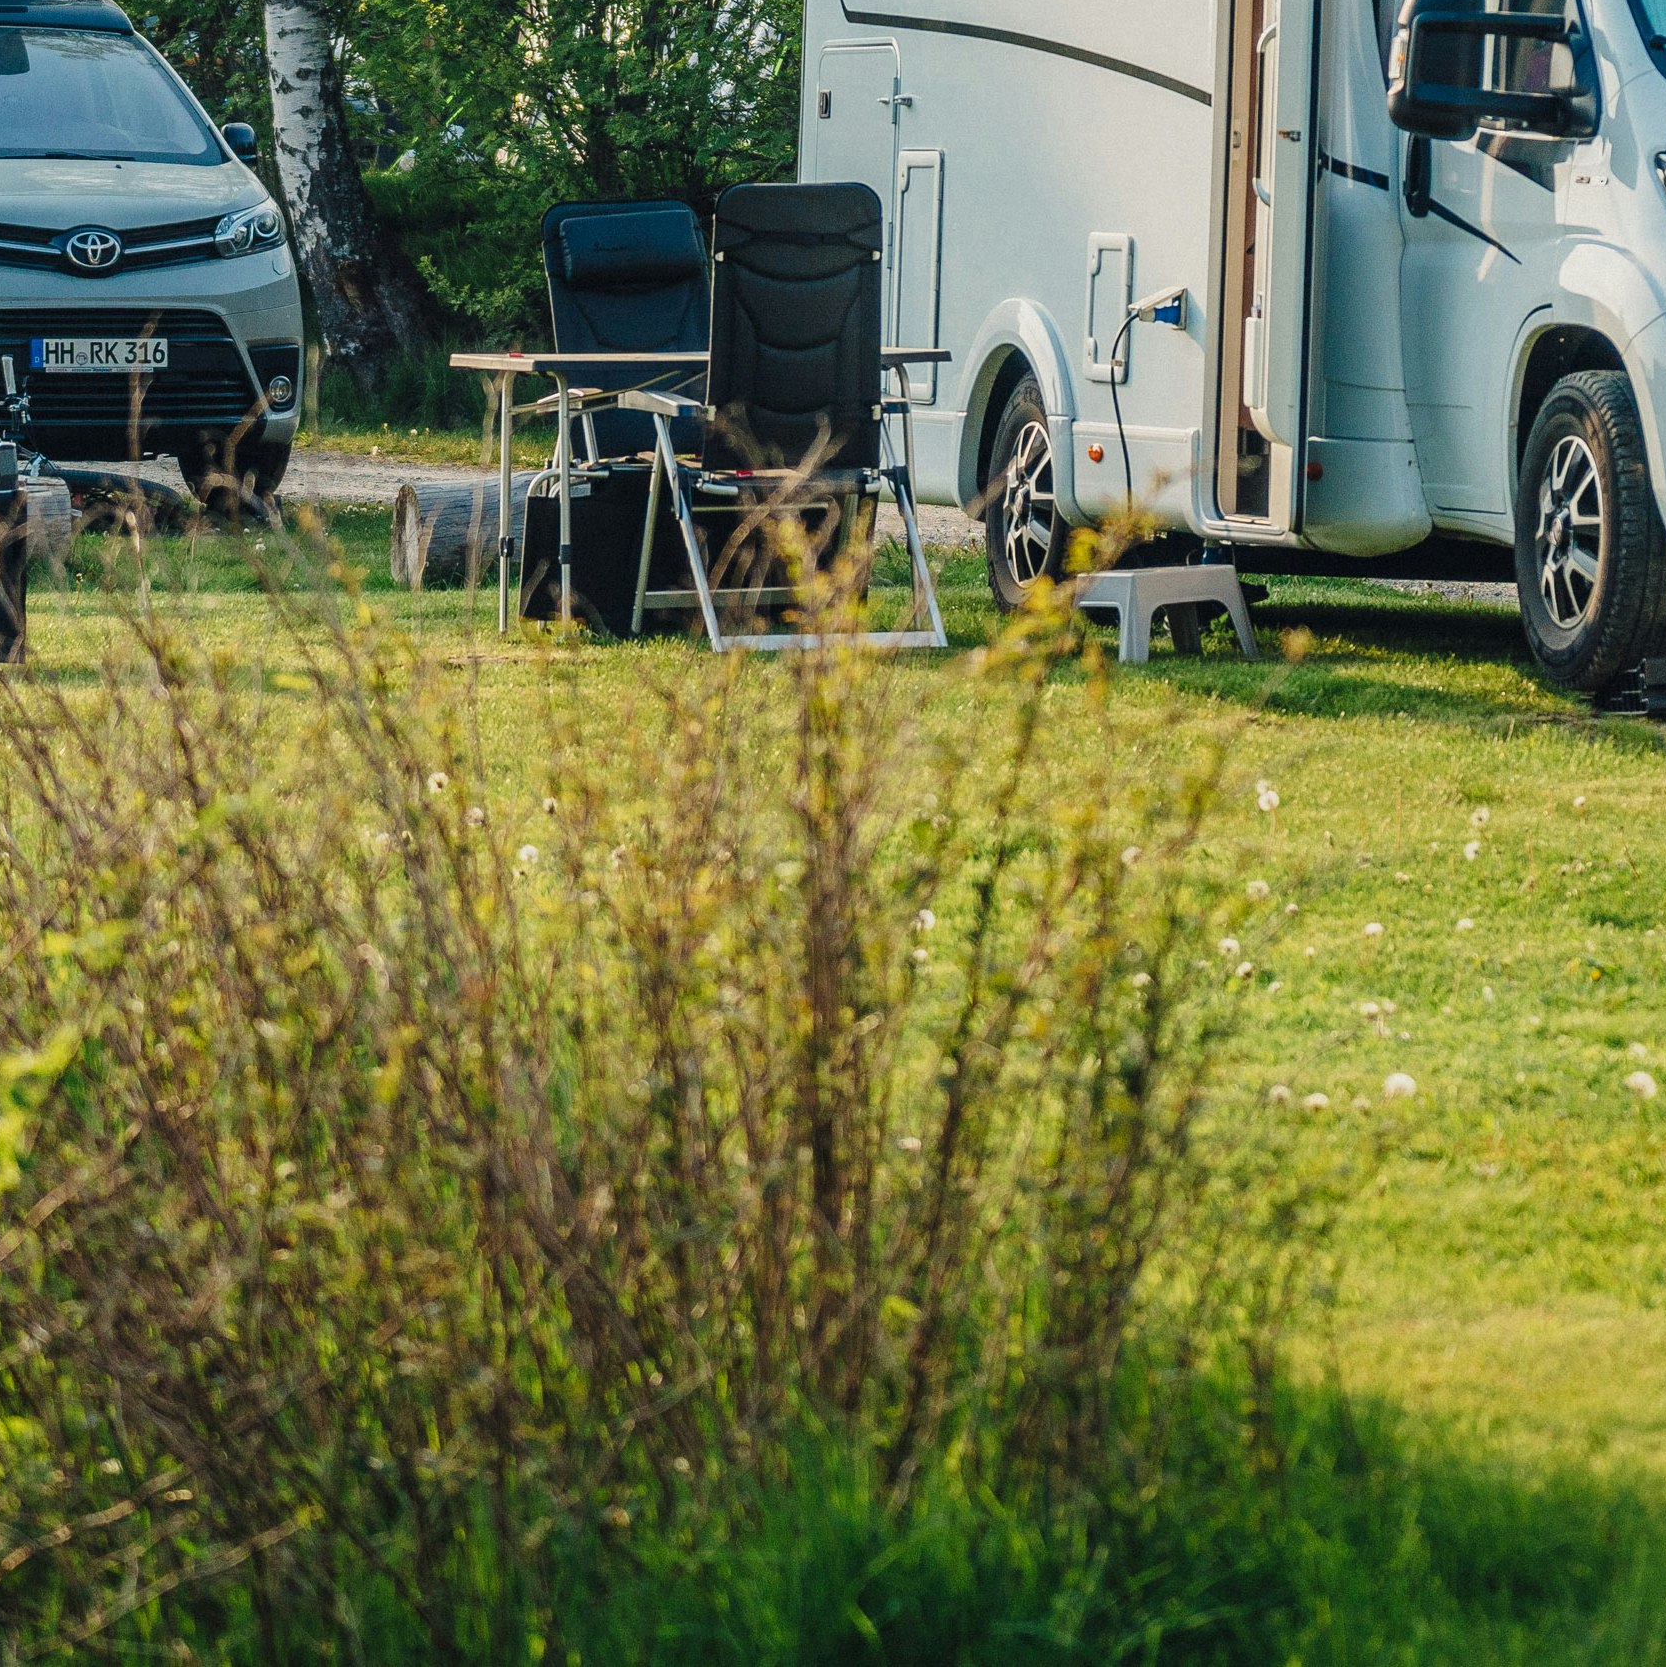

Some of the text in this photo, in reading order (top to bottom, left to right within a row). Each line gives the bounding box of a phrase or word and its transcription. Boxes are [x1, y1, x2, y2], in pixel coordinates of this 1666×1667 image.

[34, 356, 41, 364] D
[45, 341, 166, 365] HH RK 316
